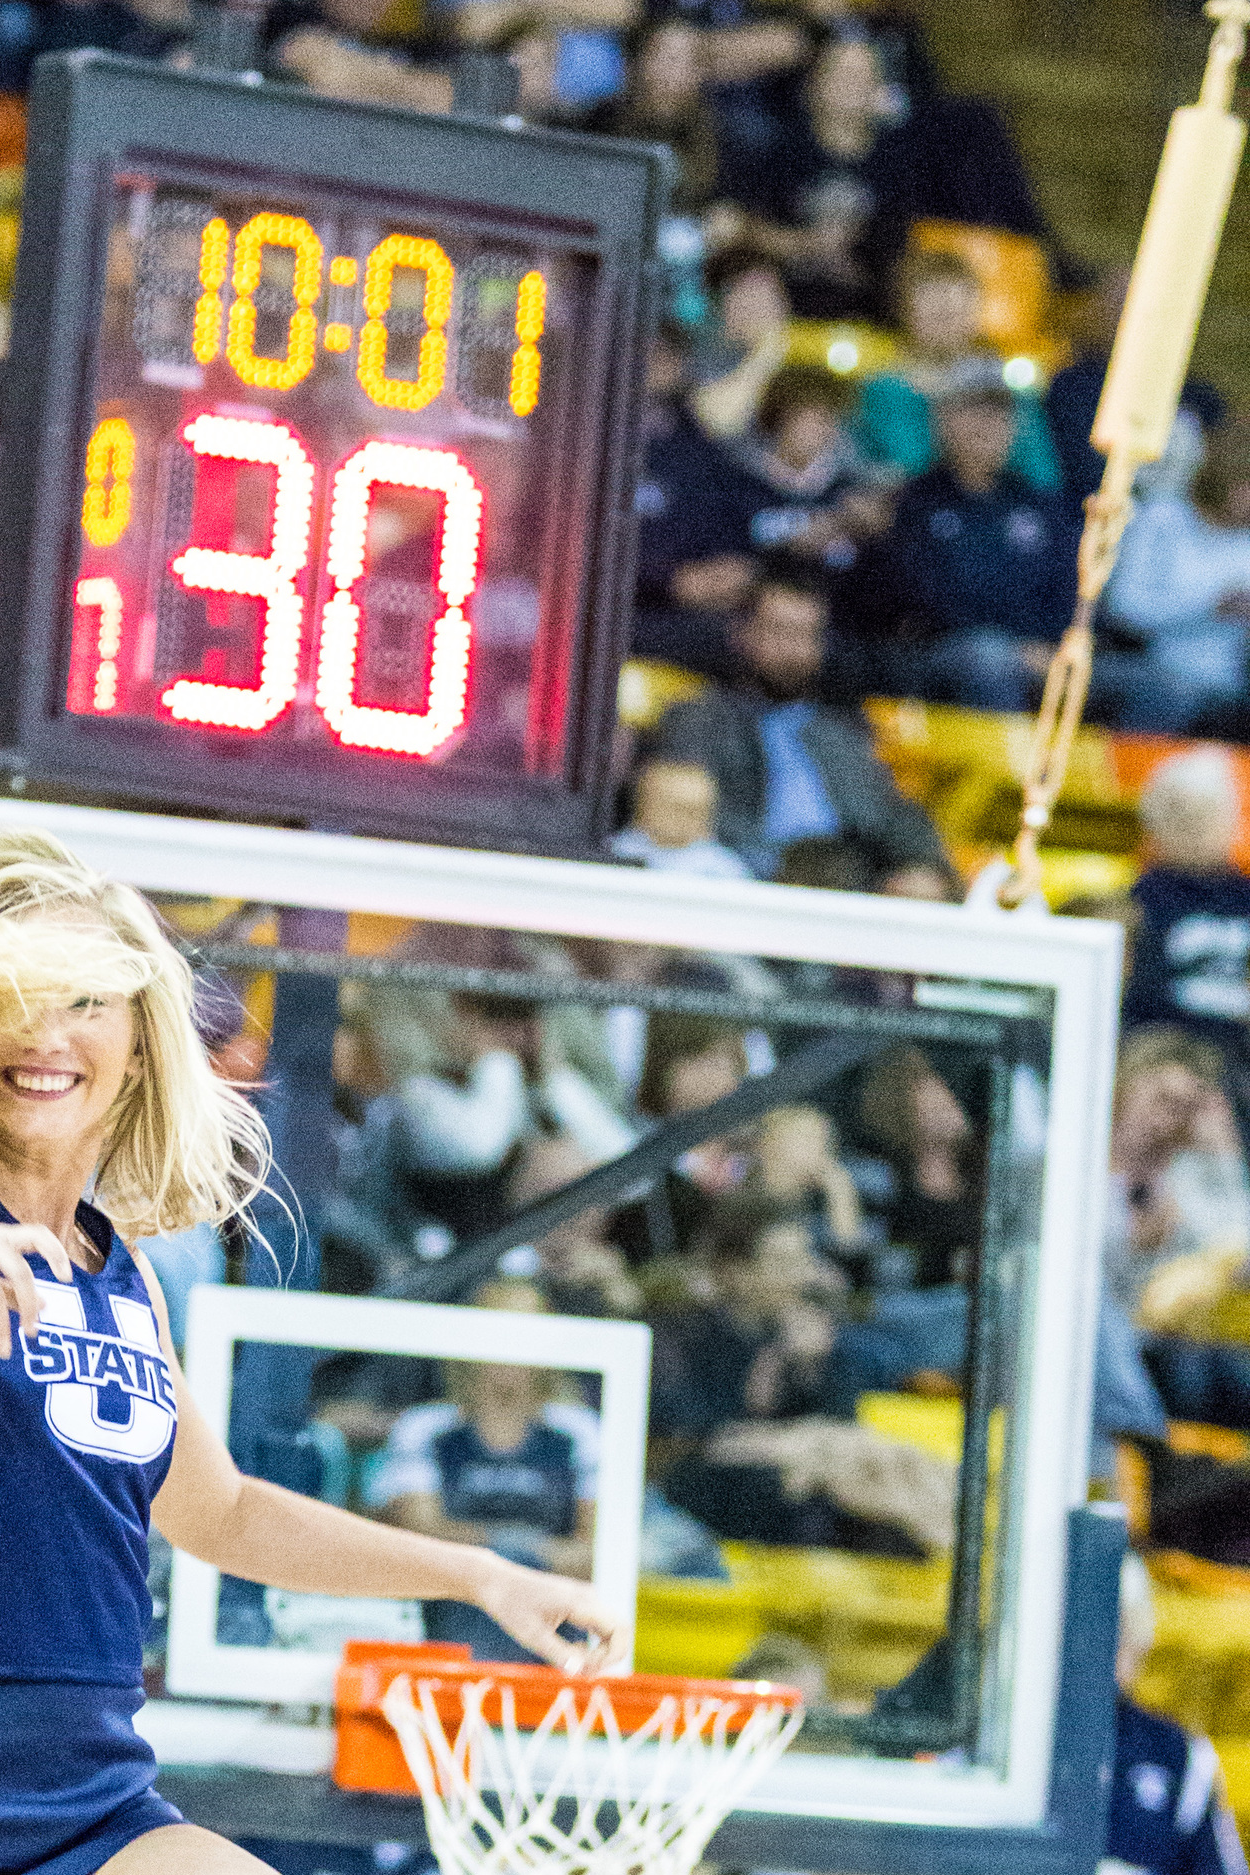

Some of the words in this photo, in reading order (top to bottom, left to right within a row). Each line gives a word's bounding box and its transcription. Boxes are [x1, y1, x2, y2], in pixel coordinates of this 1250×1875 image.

[193, 211, 547, 417] 10:01
[81, 417, 136, 547] 0
[162, 413, 484, 757] 30
[18, 1322, 179, 1422] STATE
